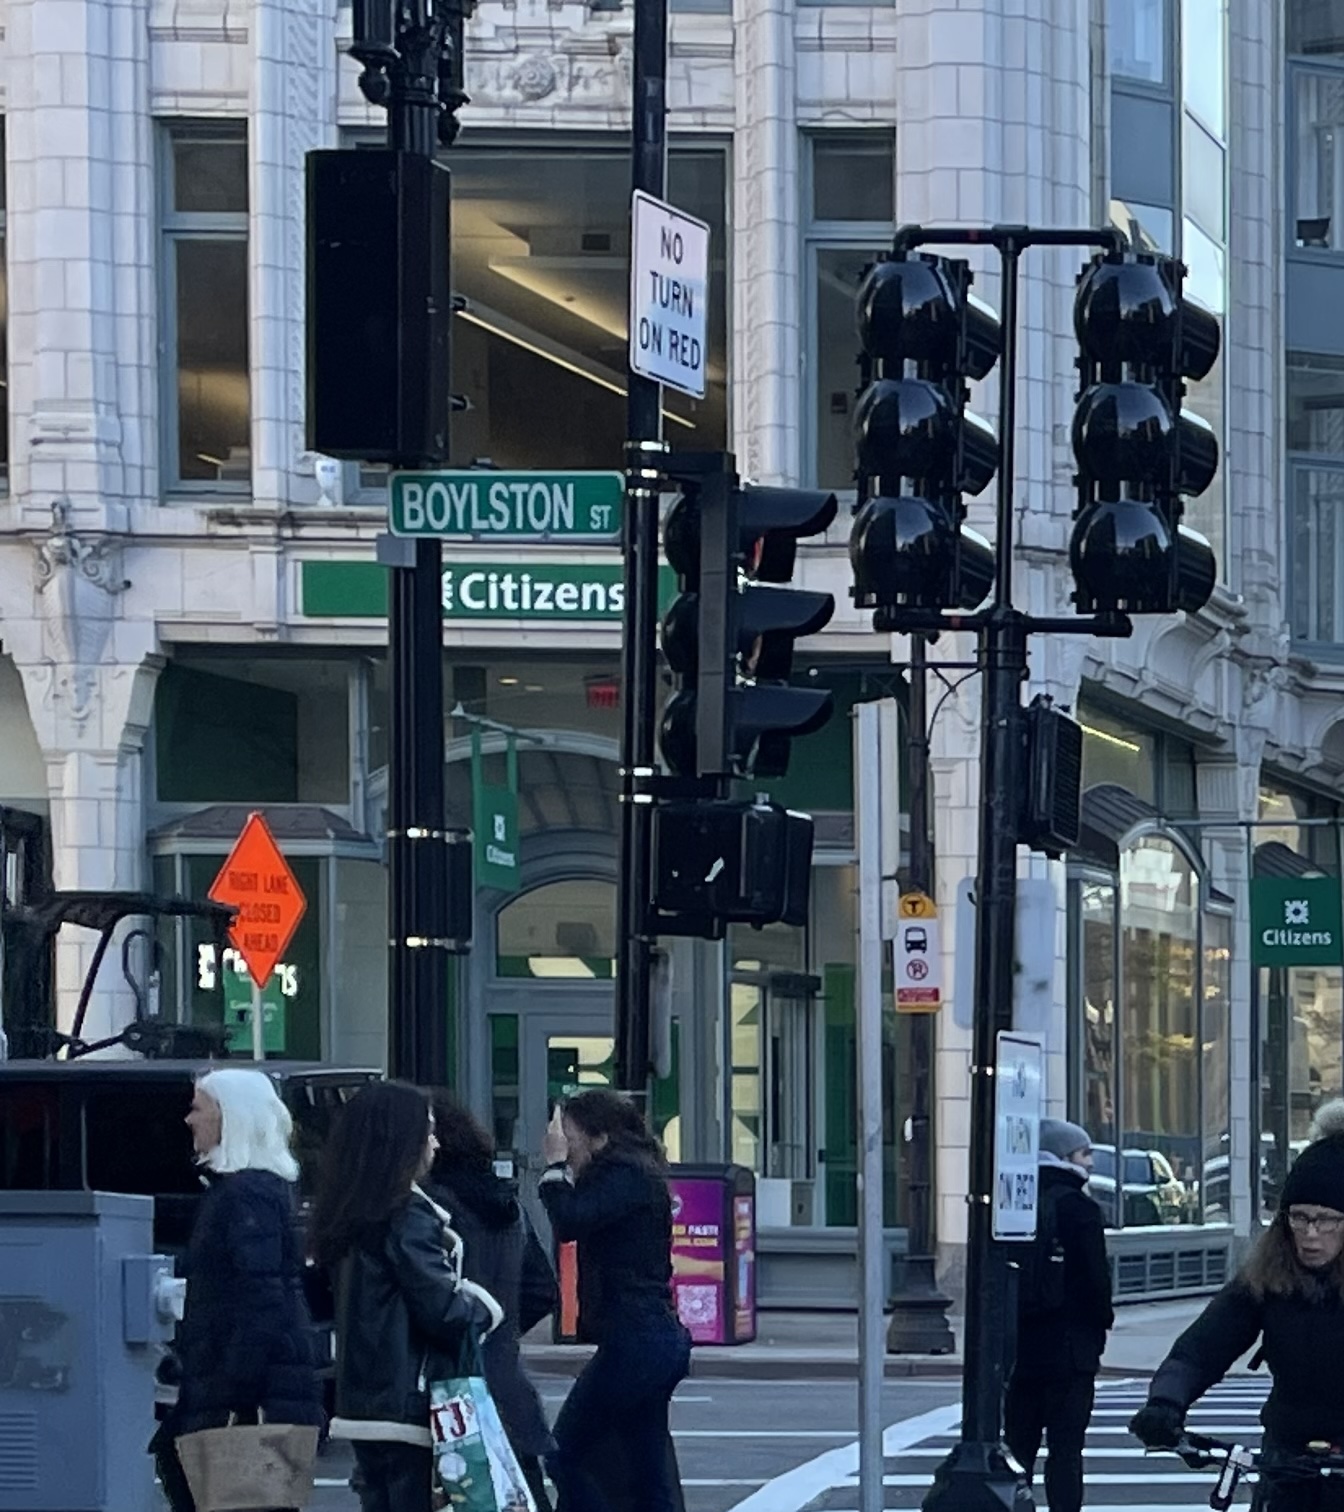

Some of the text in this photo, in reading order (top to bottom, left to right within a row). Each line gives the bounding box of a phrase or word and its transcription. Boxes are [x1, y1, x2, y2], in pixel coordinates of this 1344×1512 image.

[661, 226, 684, 265] NO
[650, 270, 694, 319] TURN
[639, 317, 701, 371] ON RED
[402, 482, 612, 530] BOYLSTON ST
[459, 572, 624, 611] Citizens
[263, 871, 289, 895] LANE
[239, 902, 281, 924] CLOSED
[243, 933, 279, 954] AHEAD
[1262, 929, 1332, 946] Citizens
